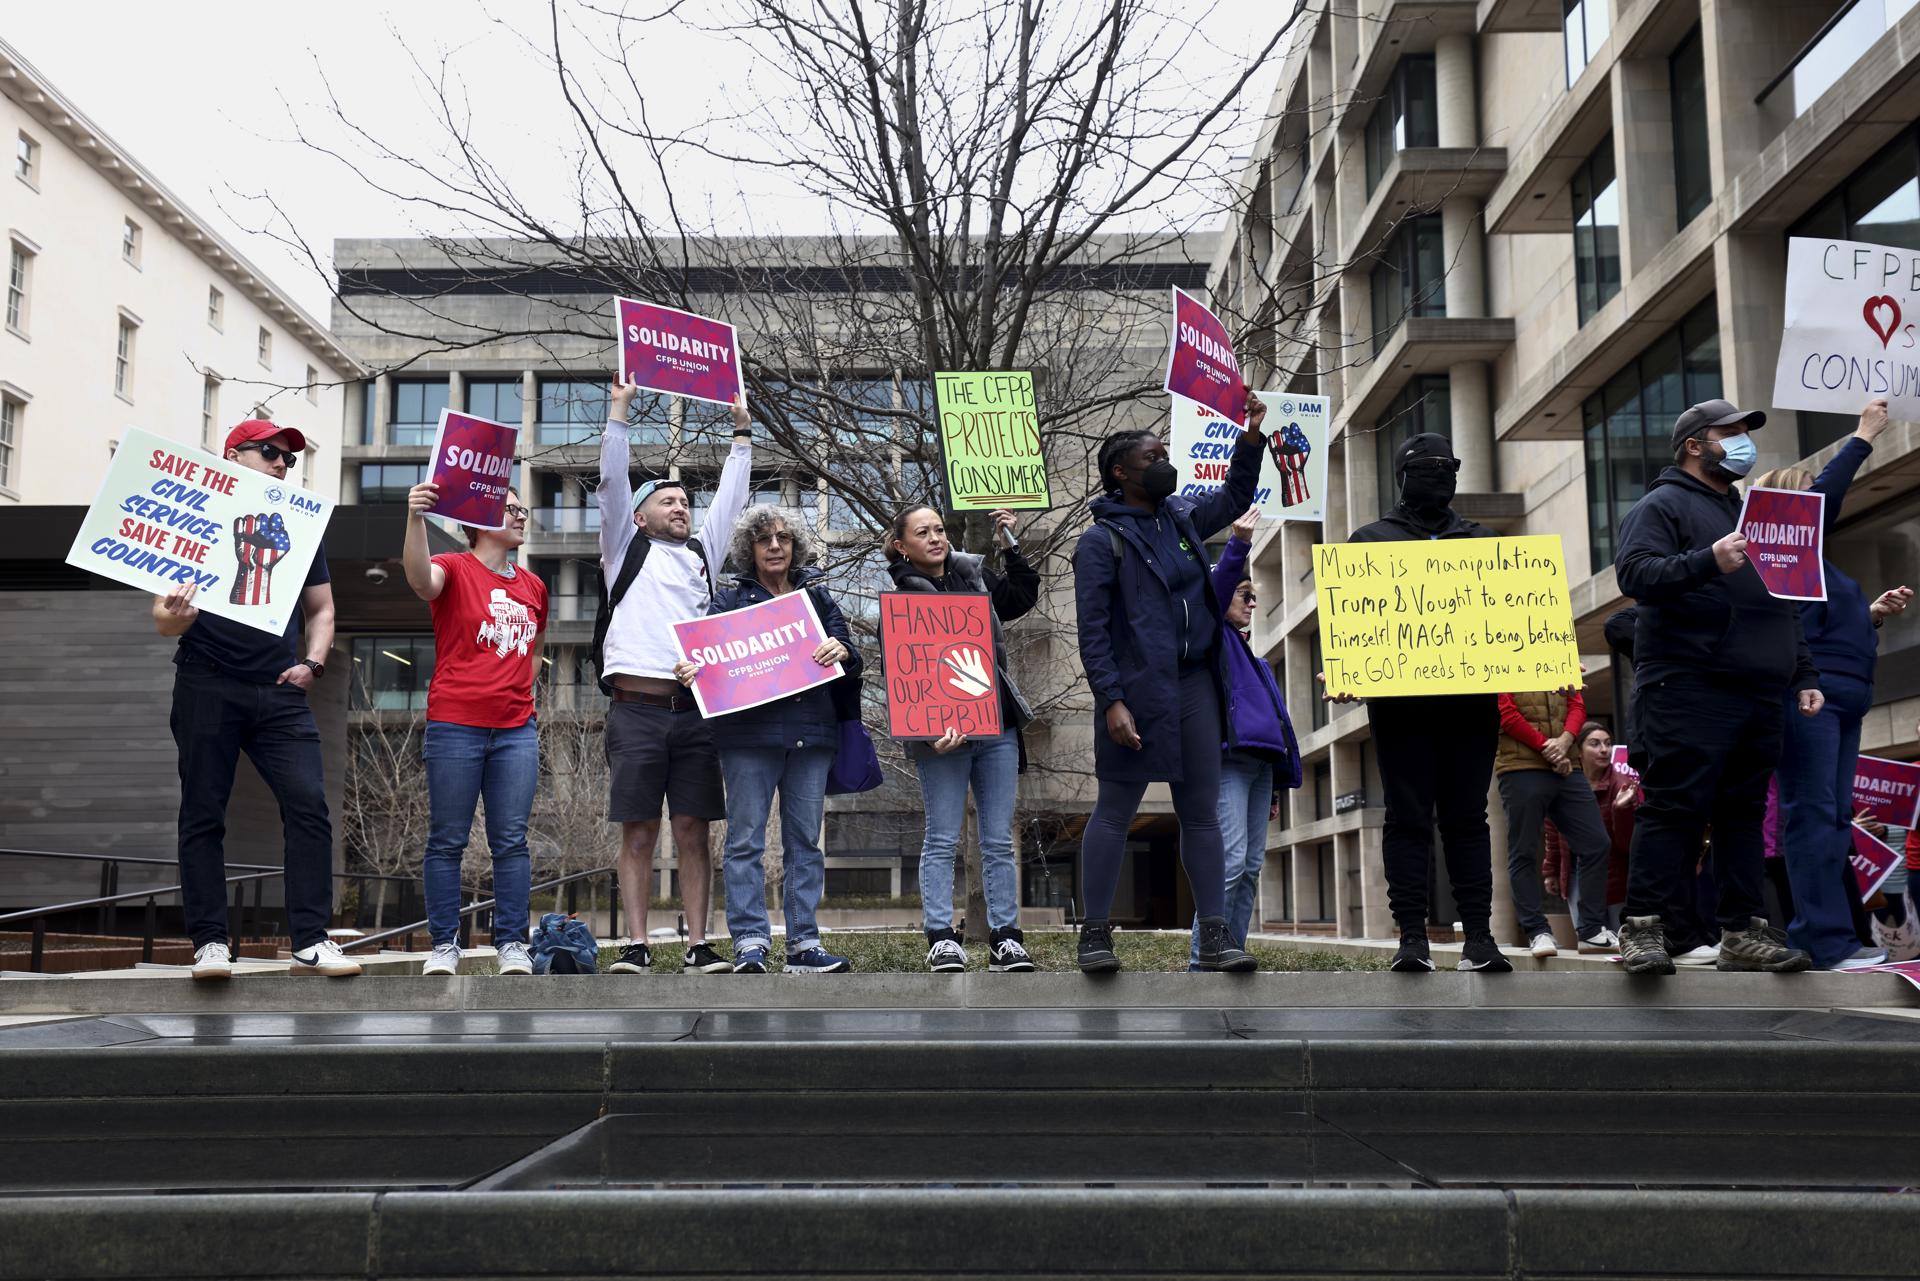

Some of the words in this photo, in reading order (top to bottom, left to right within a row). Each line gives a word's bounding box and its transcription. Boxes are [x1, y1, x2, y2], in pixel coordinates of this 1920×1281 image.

[628, 324, 729, 364] SOLIDARITY
[655, 354, 678, 365] CFPB
[679, 359, 709, 373] UNION
[1196, 359, 1210, 374] CFPB
[1211, 367, 1231, 385] UNION
[937, 376, 978, 405] THE
[983, 376, 1034, 407] CFPB
[1299, 402, 1322, 413] IAM
[943, 410, 1042, 459] PROTECTS
[149, 449, 200, 482] SAVE
[201, 467, 239, 497] THE
[469, 481, 492, 493] CFPB
[950, 460, 1047, 495] CONSUMERS
[151, 478, 210, 513] CIVIL
[289, 493, 322, 514] IAM
[290, 506, 314, 518] UNION
[119, 494, 223, 545] SERVICE,
[1744, 521, 1816, 547] SOLIDARITY
[119, 517, 171, 551] SAVE
[171, 535, 211, 564] THE
[90, 537, 220, 593] COUNTRY!
[1321, 546, 1382, 579] Musk
[1390, 554, 1408, 578] is
[1426, 541, 1557, 581] manipulating
[1759, 552, 1776, 562] CFPB
[1776, 553, 1798, 564] UNION
[889, 597, 984, 637] HANDS
[1324, 586, 1388, 617] Trump
[1411, 583, 1472, 616] Vought
[1480, 584, 1496, 608] to
[1504, 586, 1558, 608] enrich
[691, 619, 809, 668] SOLIDARITY
[1329, 618, 1391, 650] himself!
[1397, 621, 1455, 650] MAGA
[1464, 630, 1478, 647] is
[1485, 619, 1524, 652] being
[728, 664, 753, 677] CFPB
[753, 652, 790, 670] UNION
[896, 643, 937, 675] OFF
[1324, 657, 1363, 688] The
[1365, 652, 1408, 683] GOP
[1414, 653, 1455, 680] needs
[1460, 651, 1475, 679] to
[1483, 663, 1510, 683] grow
[1517, 664, 1526, 673] a
[1535, 652, 1573, 679] pair!
[893, 676, 938, 704] OUR
[1865, 795, 1892, 805] UNION
